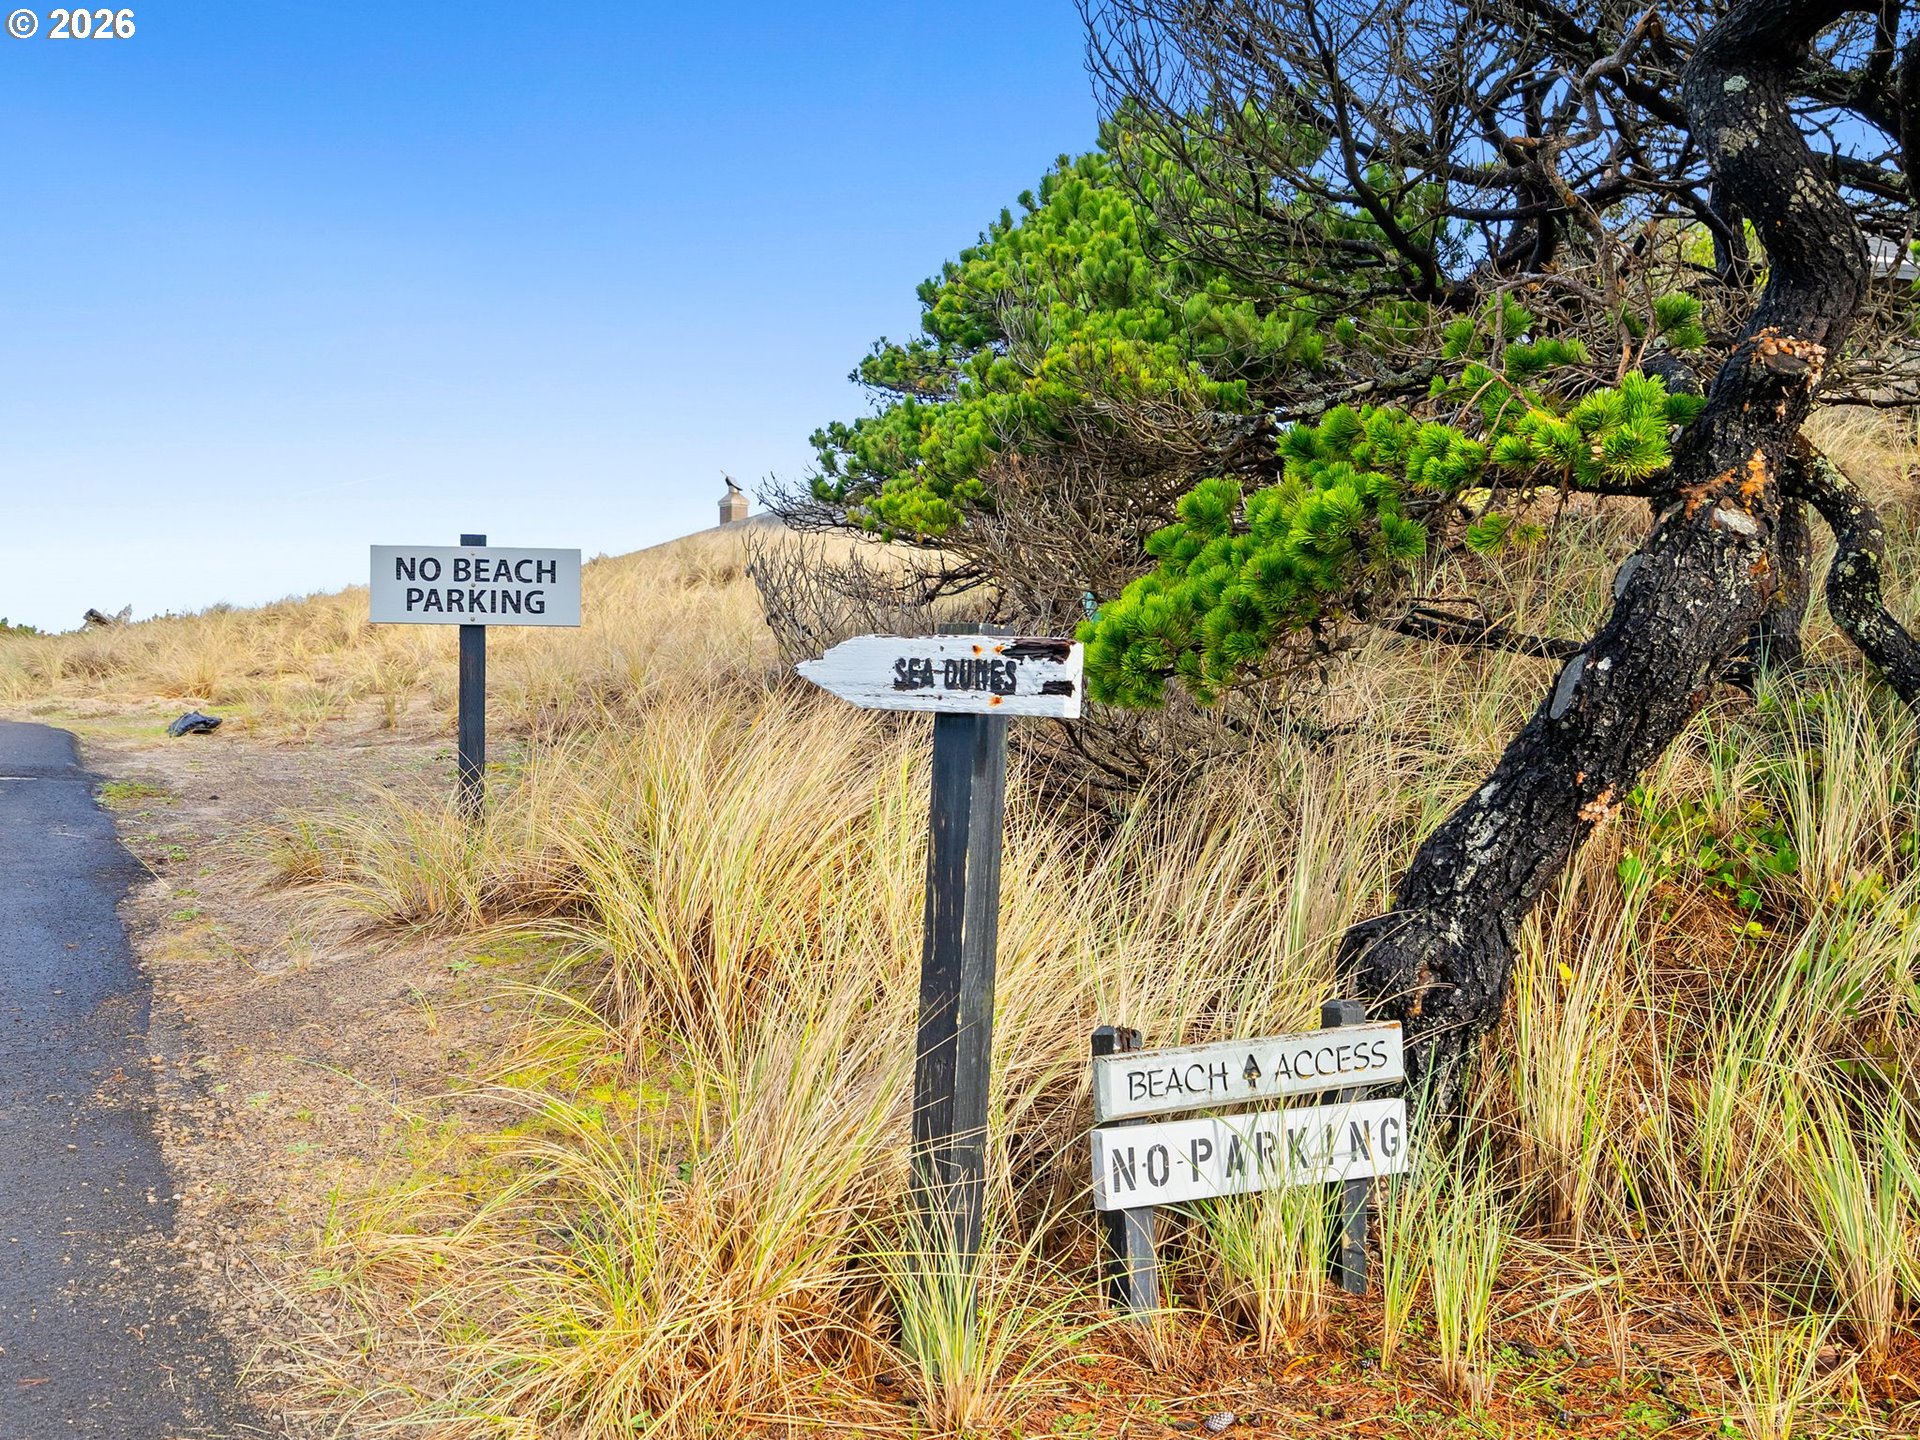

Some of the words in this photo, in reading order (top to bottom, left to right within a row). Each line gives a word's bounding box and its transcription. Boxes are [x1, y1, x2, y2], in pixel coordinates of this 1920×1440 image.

[395, 557, 442, 582] NO
[453, 558, 557, 584] BEACH
[406, 588, 546, 614] PARKING
[894, 657, 936, 690] SEA
[944, 658, 1018, 695] DUNES
[1127, 1061, 1229, 1101] BEACH
[1274, 1040, 1388, 1081] ACCESS
[1112, 1143, 1170, 1193] NO
[1190, 1117, 1401, 1183] PARKING
